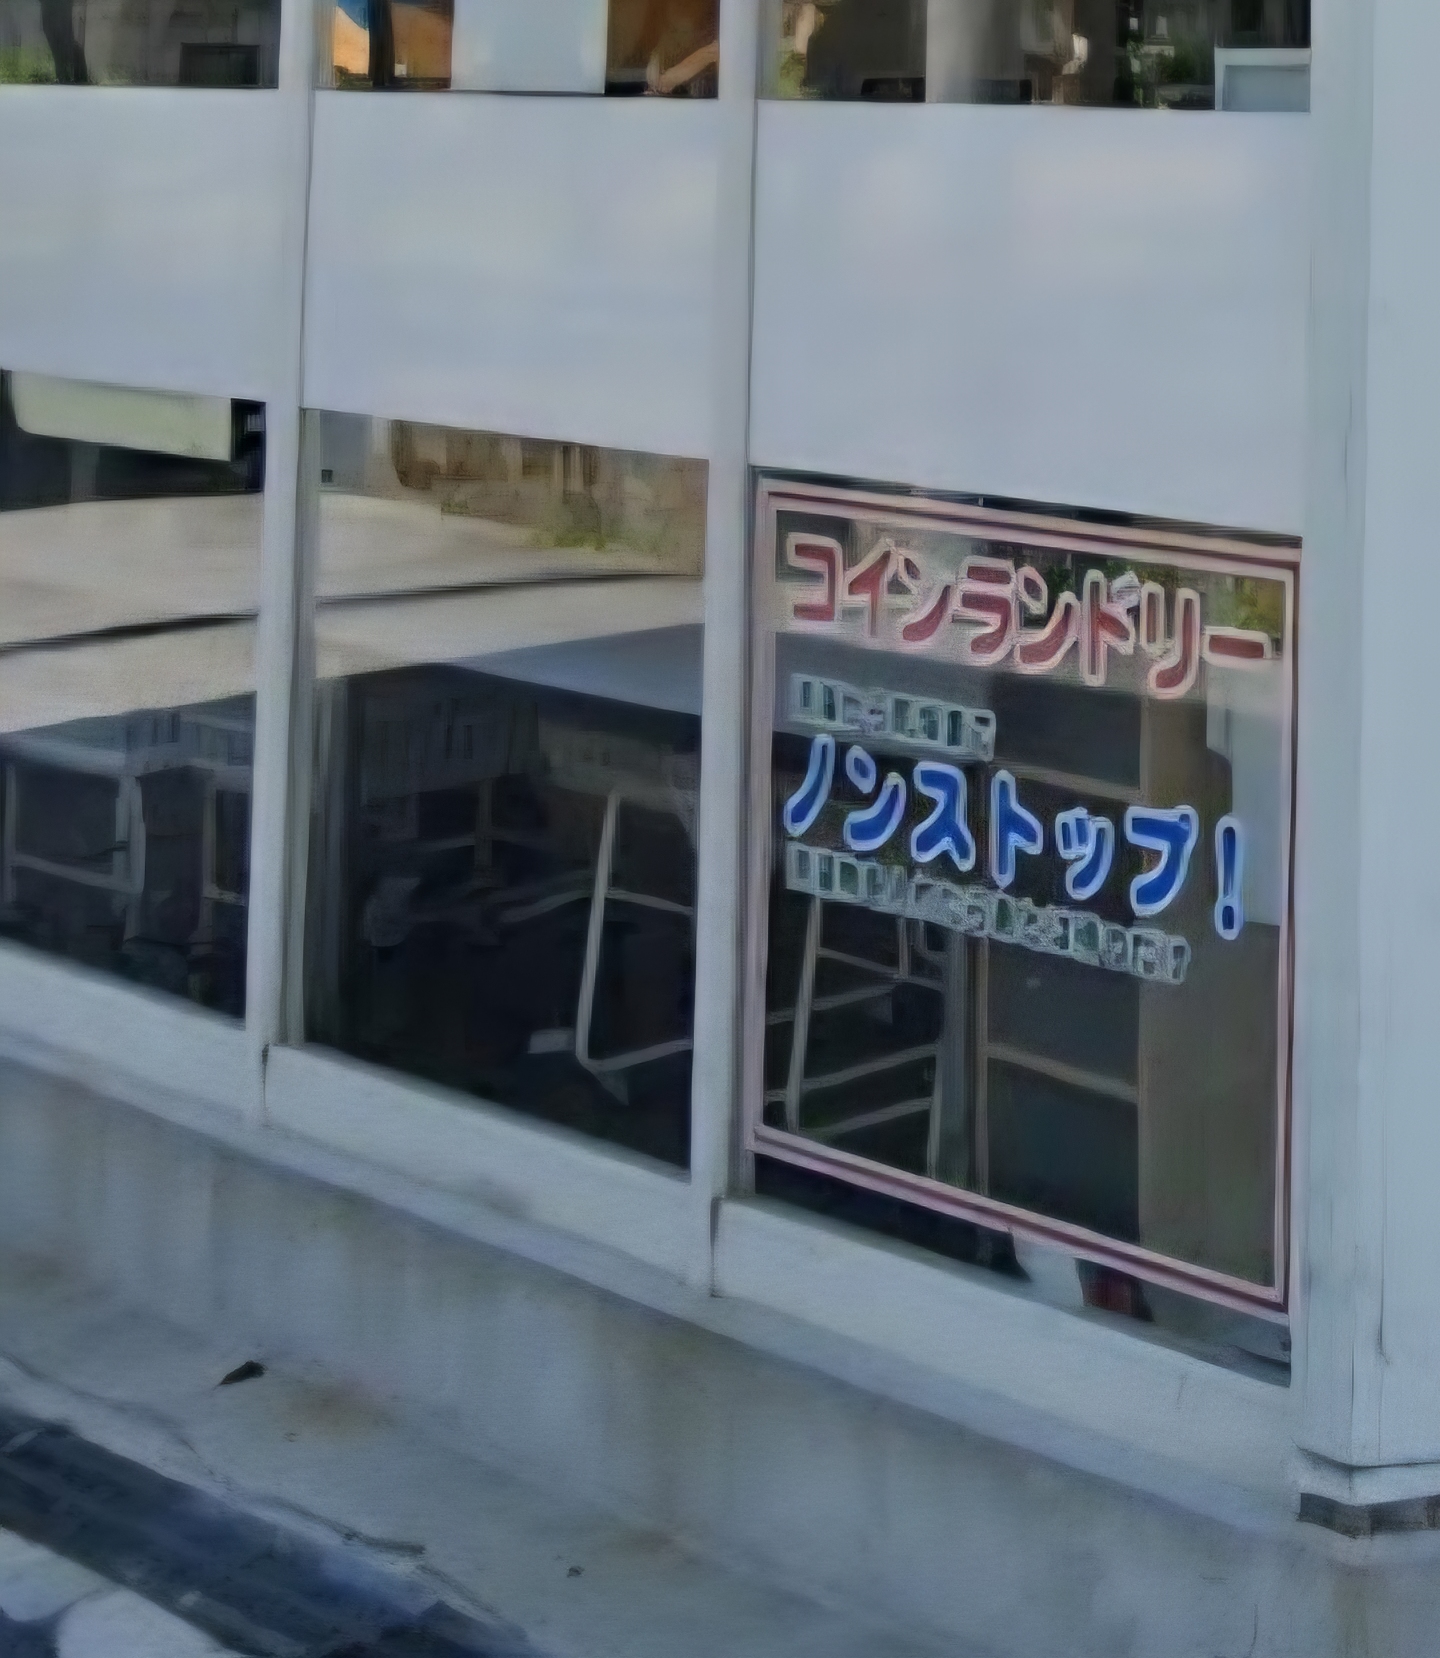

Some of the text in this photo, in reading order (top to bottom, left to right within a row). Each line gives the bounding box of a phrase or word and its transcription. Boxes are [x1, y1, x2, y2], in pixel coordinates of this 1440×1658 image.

[786, 530, 1278, 700] コインランドリー
